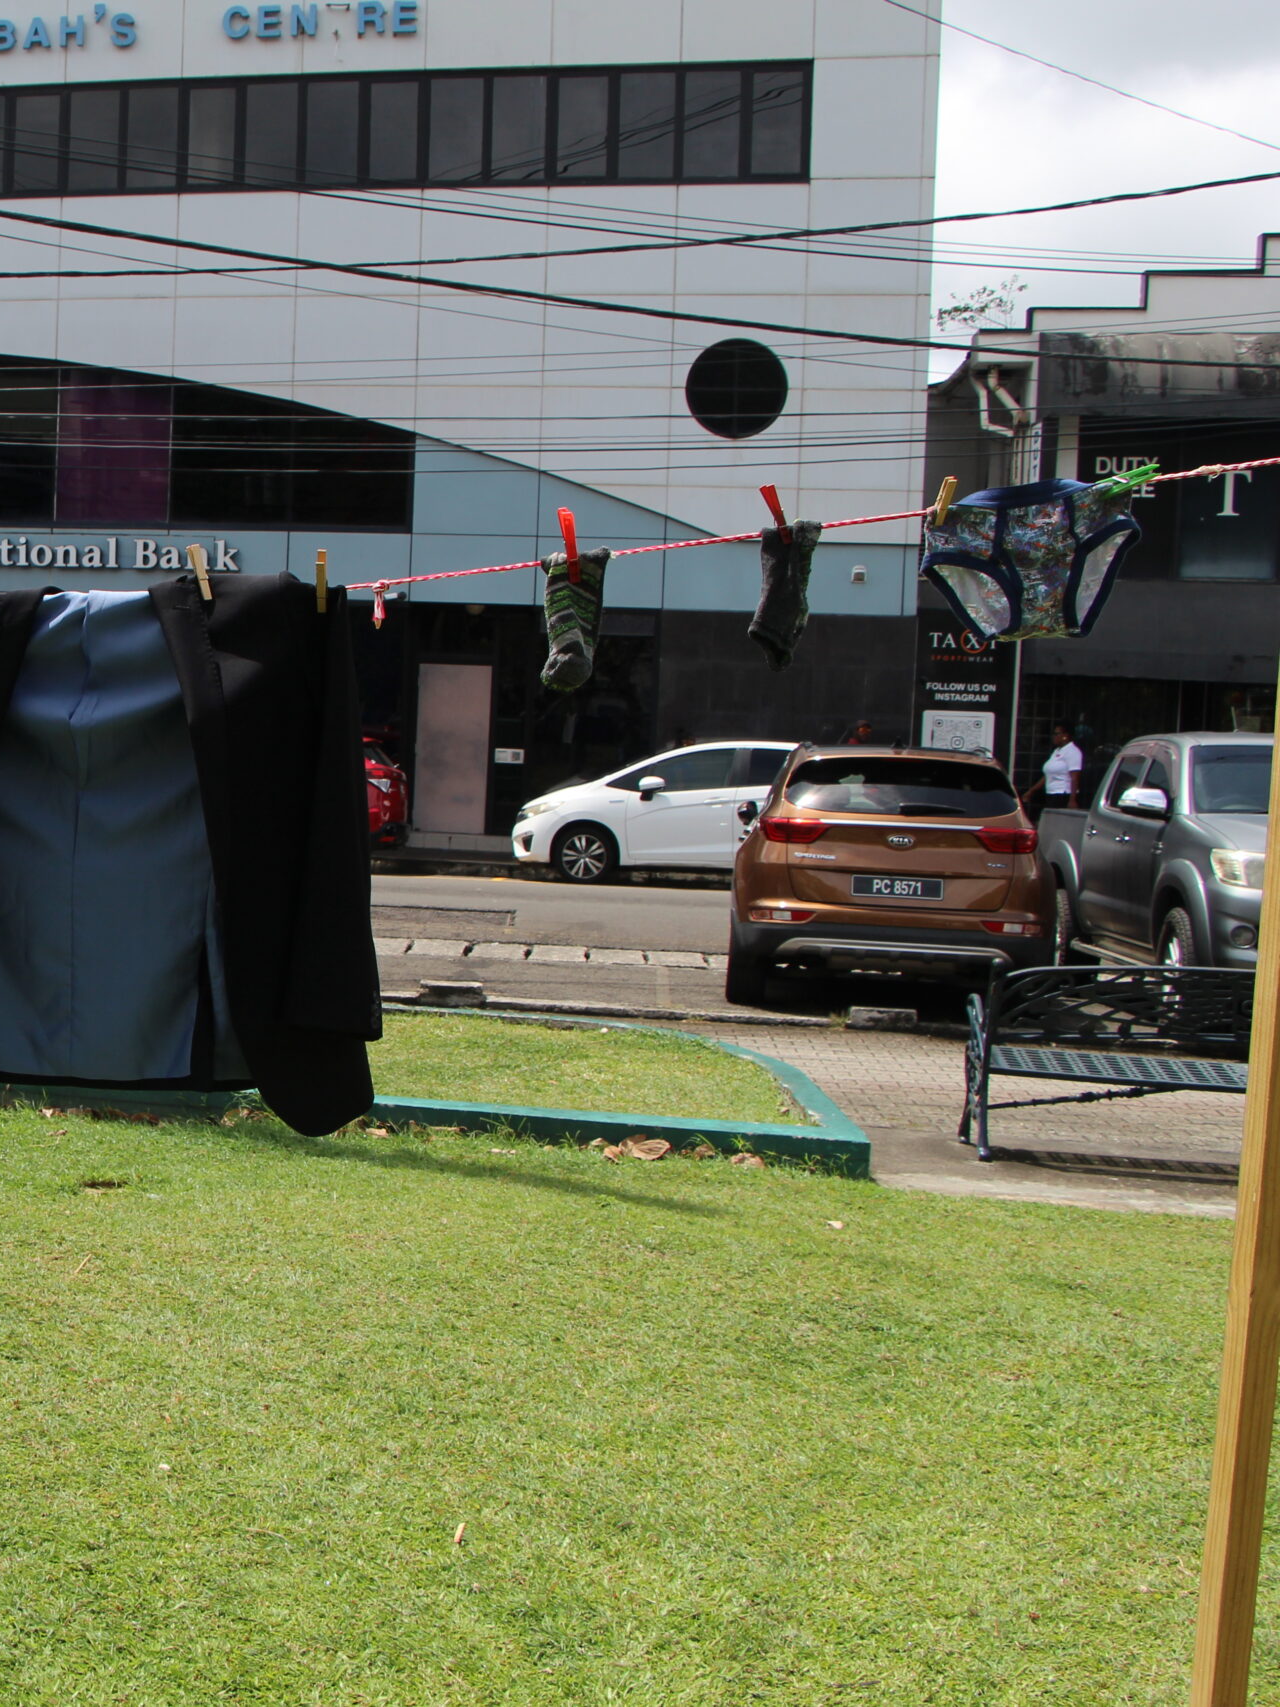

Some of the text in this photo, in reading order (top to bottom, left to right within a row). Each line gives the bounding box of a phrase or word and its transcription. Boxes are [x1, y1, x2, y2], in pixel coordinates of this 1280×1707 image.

[223, 0, 417, 39] CENRE
[926, 682, 997, 692] FOLLOW US ON
[934, 693, 990, 702] INSTAGRAM
[872, 879, 922, 895] PC 8571
